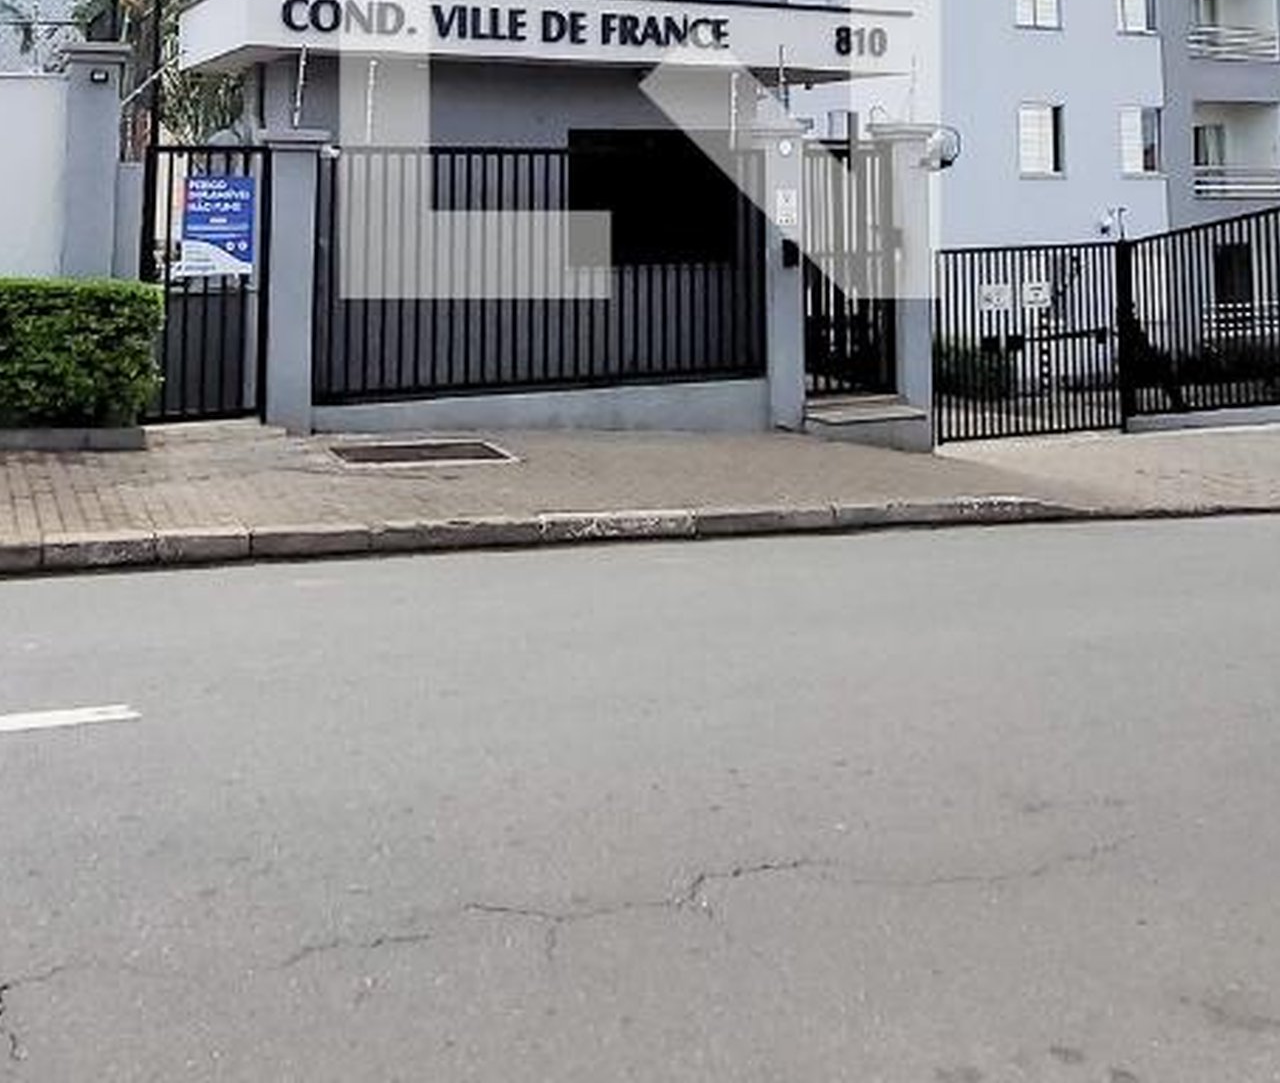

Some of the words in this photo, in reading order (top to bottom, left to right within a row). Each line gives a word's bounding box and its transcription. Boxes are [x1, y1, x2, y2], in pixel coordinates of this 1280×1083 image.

[431, 3, 528, 42] VILLE
[541, 9, 588, 44] DE
[600, 13, 730, 50] FRANCE
[834, 26, 887, 57] 810
